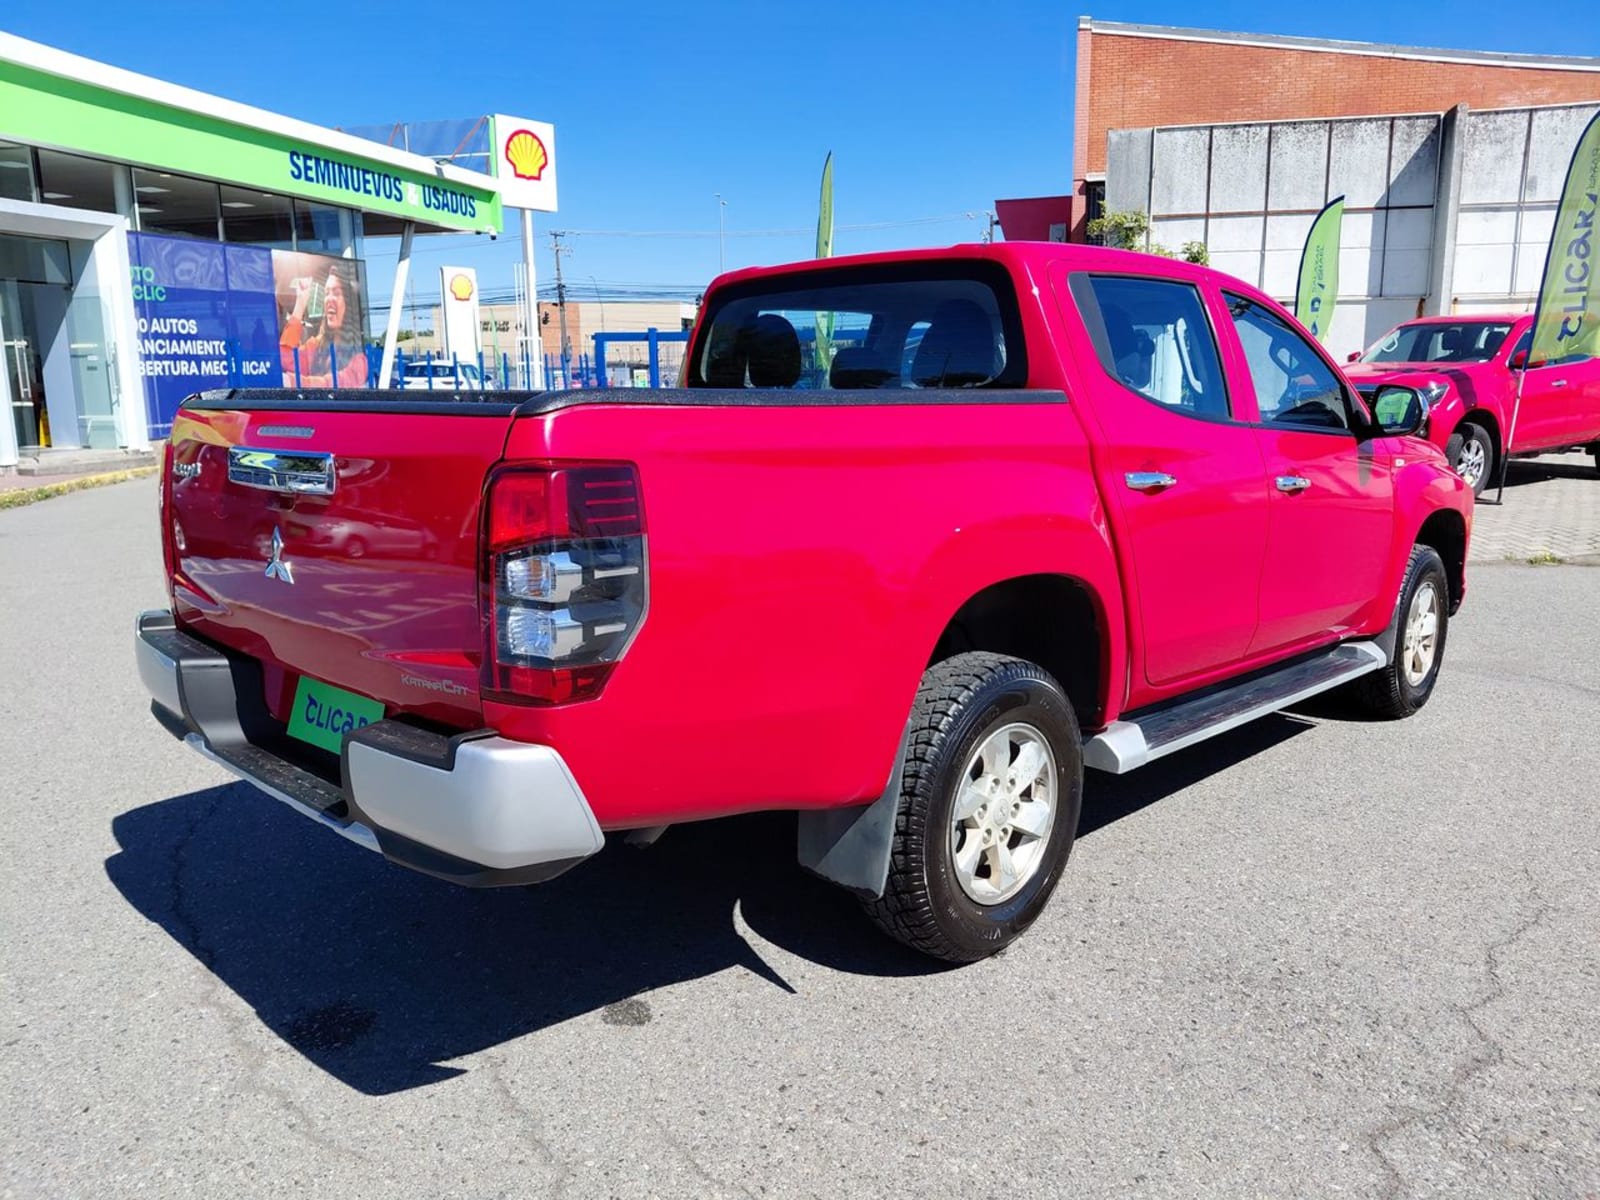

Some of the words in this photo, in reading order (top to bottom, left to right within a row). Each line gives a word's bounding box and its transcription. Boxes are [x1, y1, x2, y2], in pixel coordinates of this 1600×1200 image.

[289, 150, 403, 203] SEMINUEVOS
[407, 182, 419, 207] &
[422, 183, 477, 218] USADOS
[131, 266, 155, 283] TO
[132, 284, 166, 302] CLIC
[151, 318, 198, 335] AUTOS
[139, 359, 199, 377] BERTURA
